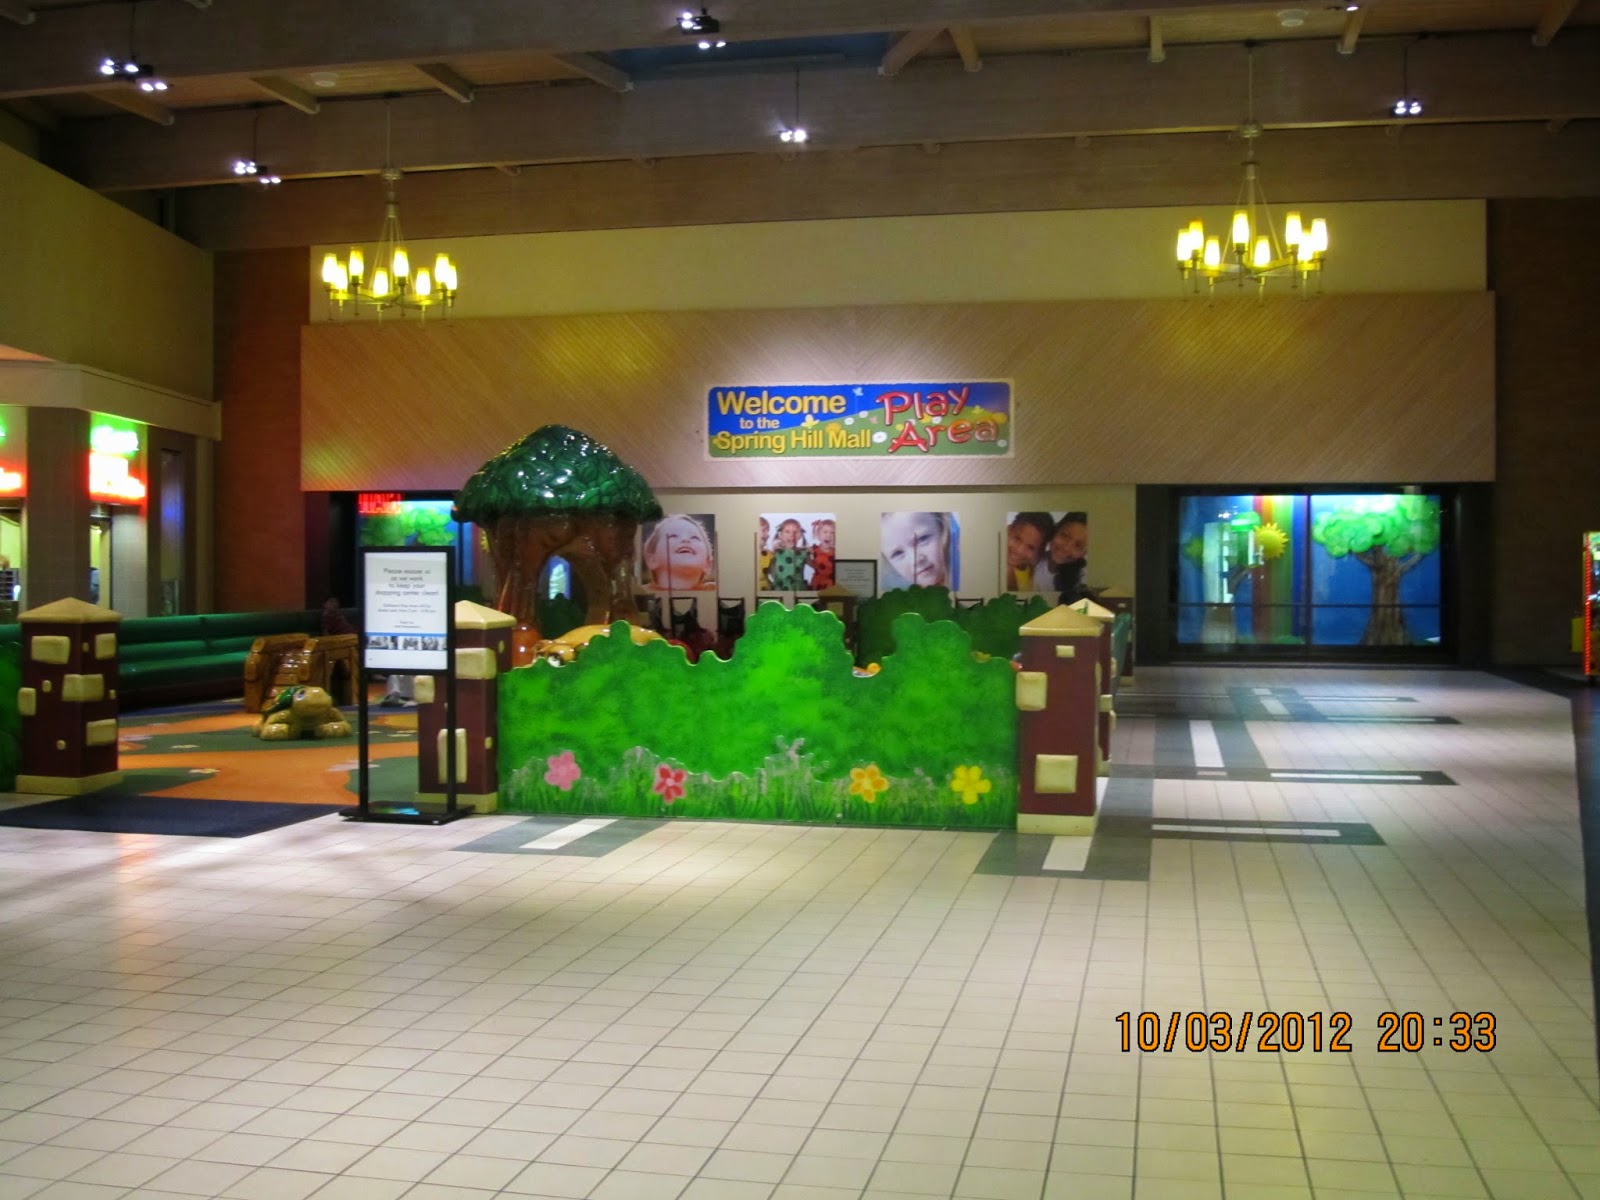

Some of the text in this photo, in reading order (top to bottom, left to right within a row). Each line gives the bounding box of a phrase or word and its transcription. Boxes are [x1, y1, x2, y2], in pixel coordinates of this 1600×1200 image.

[717, 391, 847, 415] Welcome
[876, 386, 970, 426] Play
[740, 417, 780, 429] to the
[887, 416, 999, 454] Area
[716, 429, 871, 454] Spring Hill Mall
